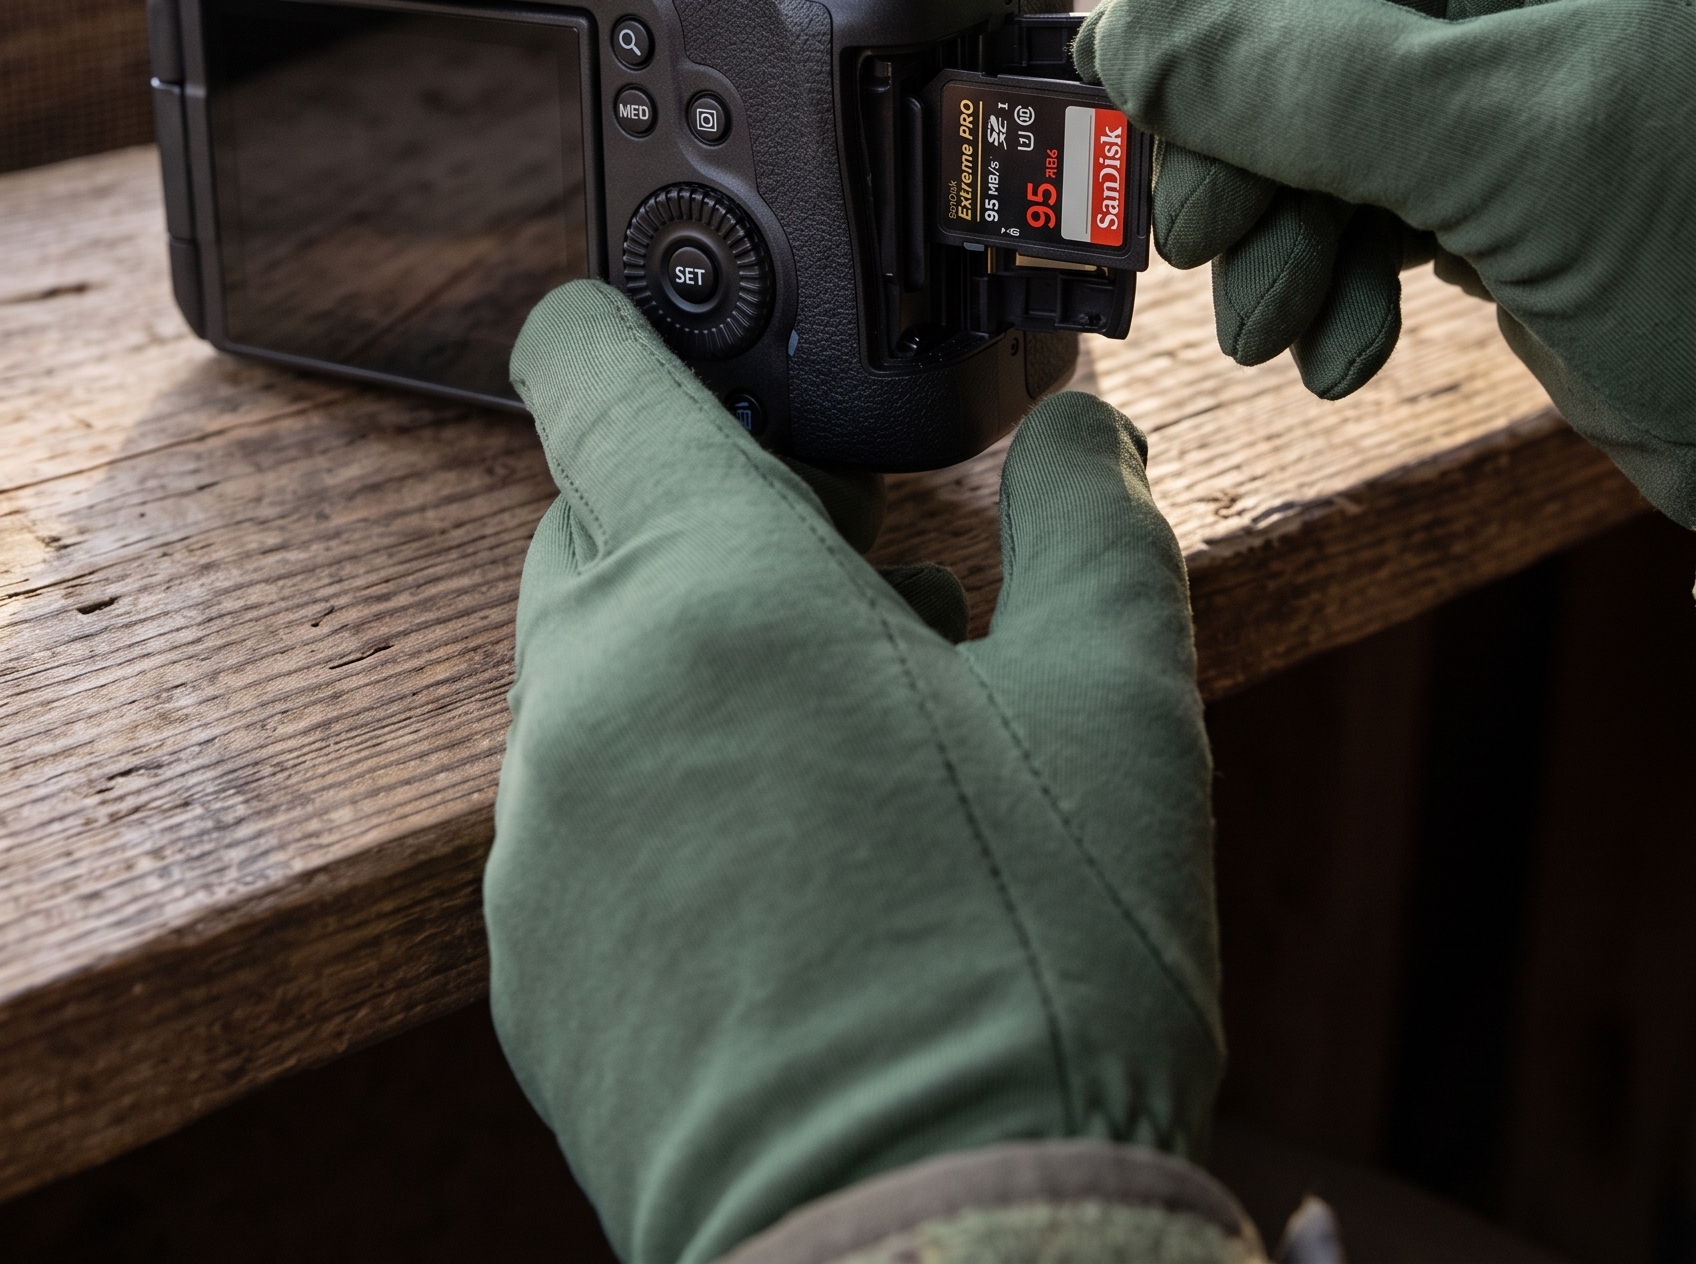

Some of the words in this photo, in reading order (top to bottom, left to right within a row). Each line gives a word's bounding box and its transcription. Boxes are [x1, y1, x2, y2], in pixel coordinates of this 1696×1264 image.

[619, 104, 649, 121] MED
[959, 99, 974, 141] PRO
[958, 143, 974, 221] Extreme
[988, 161, 1000, 196] MB/s
[1096, 126, 1123, 230] SanDisk
[984, 199, 999, 222] 95
[1026, 182, 1057, 229] 95
[675, 266, 706, 286] SET
